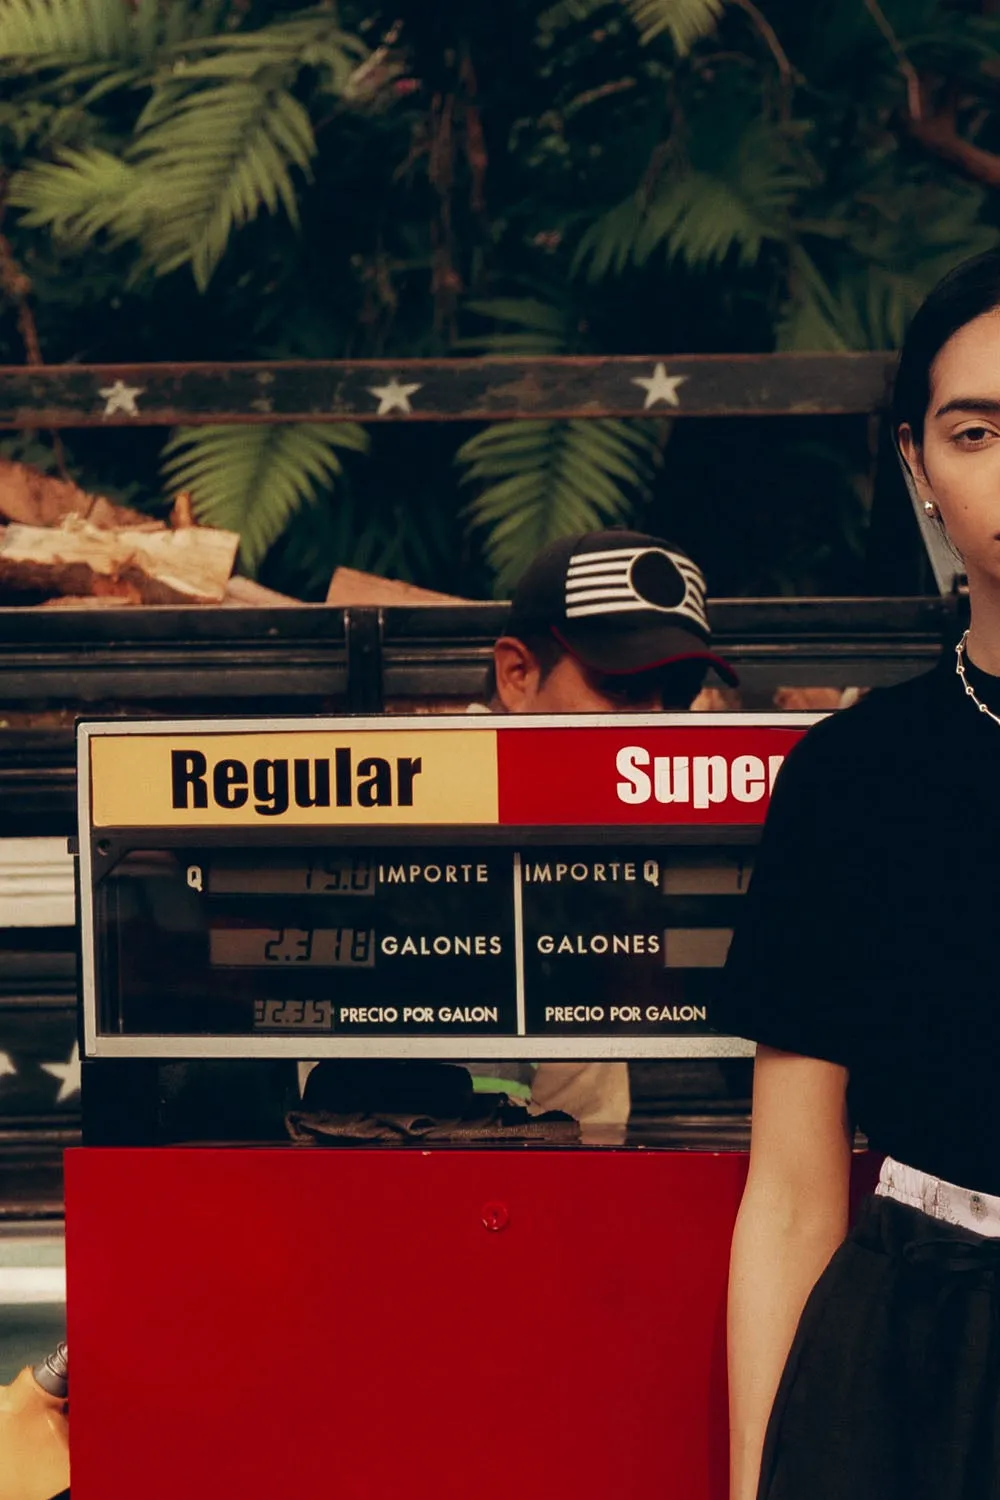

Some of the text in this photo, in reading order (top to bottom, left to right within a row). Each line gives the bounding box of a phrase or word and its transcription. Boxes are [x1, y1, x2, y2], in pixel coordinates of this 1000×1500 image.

[171, 747, 422, 816] Regular
[186, 865, 203, 892] Q
[379, 864, 489, 884] IMPORTE
[525, 861, 660, 887] IMPORTE Q
[381, 935, 502, 956] GALONES
[537, 934, 661, 954] GALONES
[340, 1006, 499, 1024] PRECIO POR GALON
[545, 1004, 707, 1022] PRECIO POR GALON
